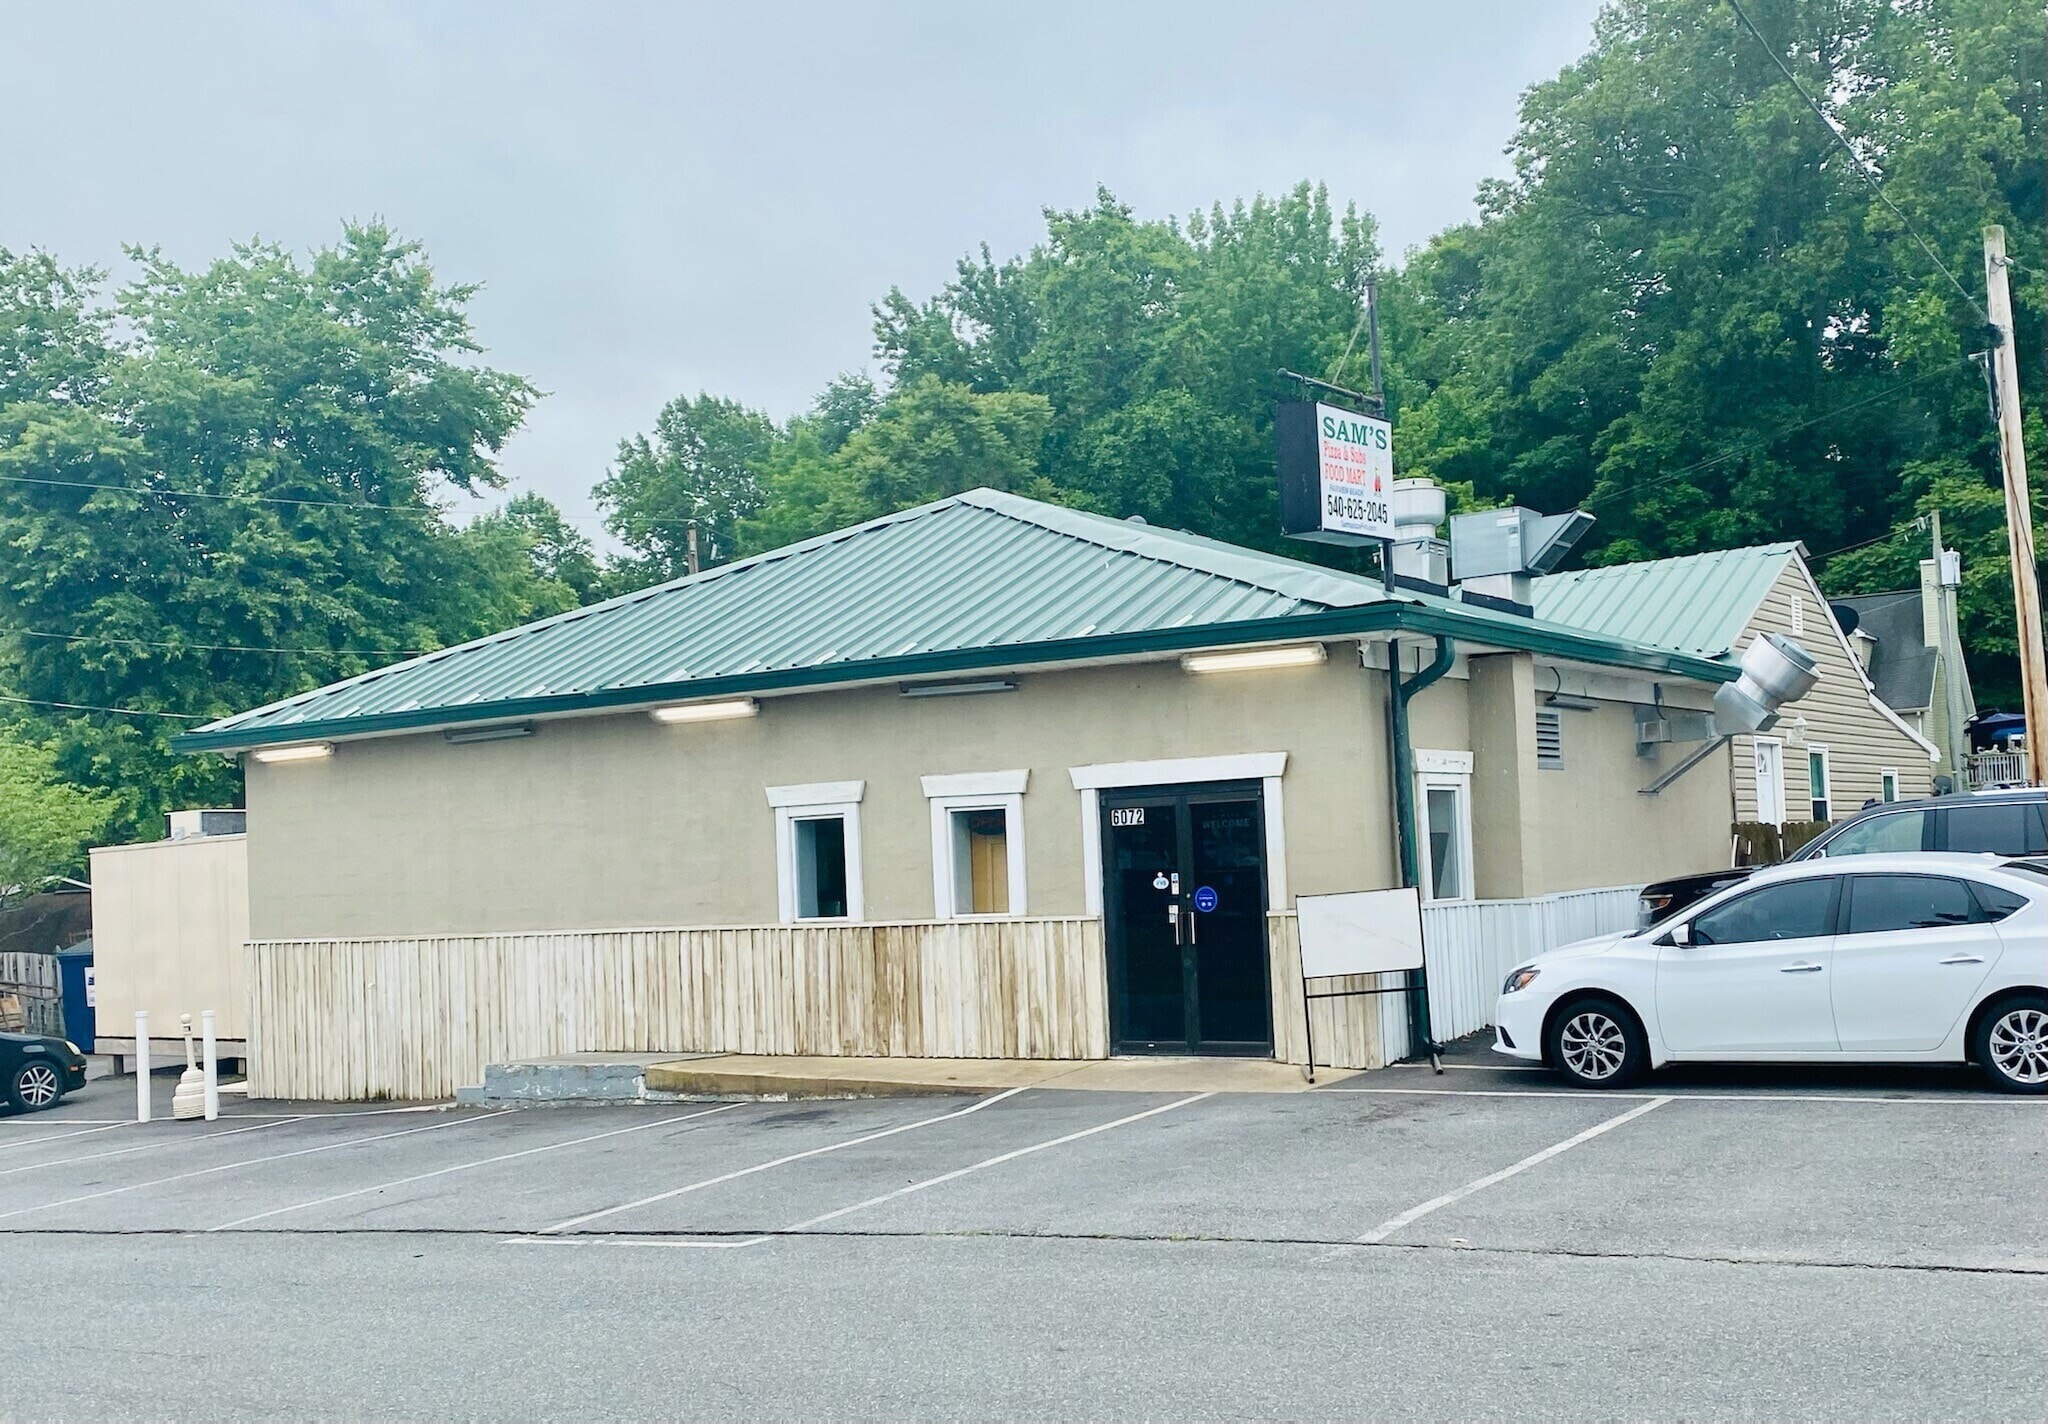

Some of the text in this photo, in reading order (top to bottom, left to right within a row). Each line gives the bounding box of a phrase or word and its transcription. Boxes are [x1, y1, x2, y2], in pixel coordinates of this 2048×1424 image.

[1323, 416, 1387, 450] SAM'S
[1323, 440, 1367, 464] Pizza & Subs
[1325, 463, 1366, 486] FOOD MART
[1328, 494, 1388, 524] 540-625-2045
[1112, 810, 1143, 825] 6072
[1203, 818, 1250, 829] WELCOME
